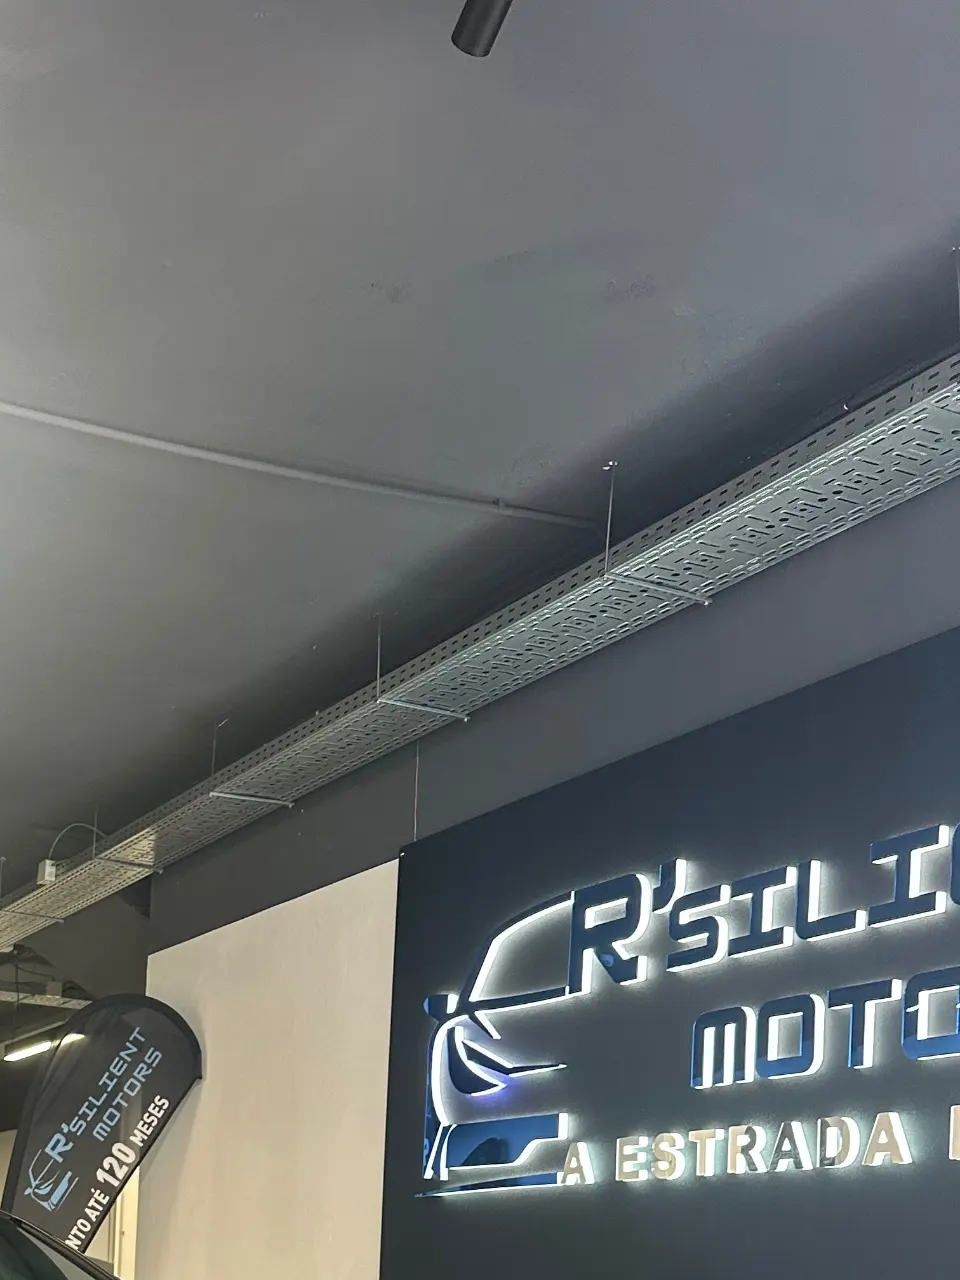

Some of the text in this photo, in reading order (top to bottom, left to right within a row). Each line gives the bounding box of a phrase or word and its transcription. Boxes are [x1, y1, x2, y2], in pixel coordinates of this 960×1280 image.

[568, 820, 960, 994] R'SILI
[44, 1026, 146, 1163] R'SILIENT
[92, 1047, 163, 1142] MOTORS
[129, 1095, 170, 1147] MESES
[96, 1142, 136, 1188] 120
[560, 1141, 595, 1185] A
[615, 1111, 914, 1183] ESTRADA
[84, 1187, 110, 1222] ATÉ
